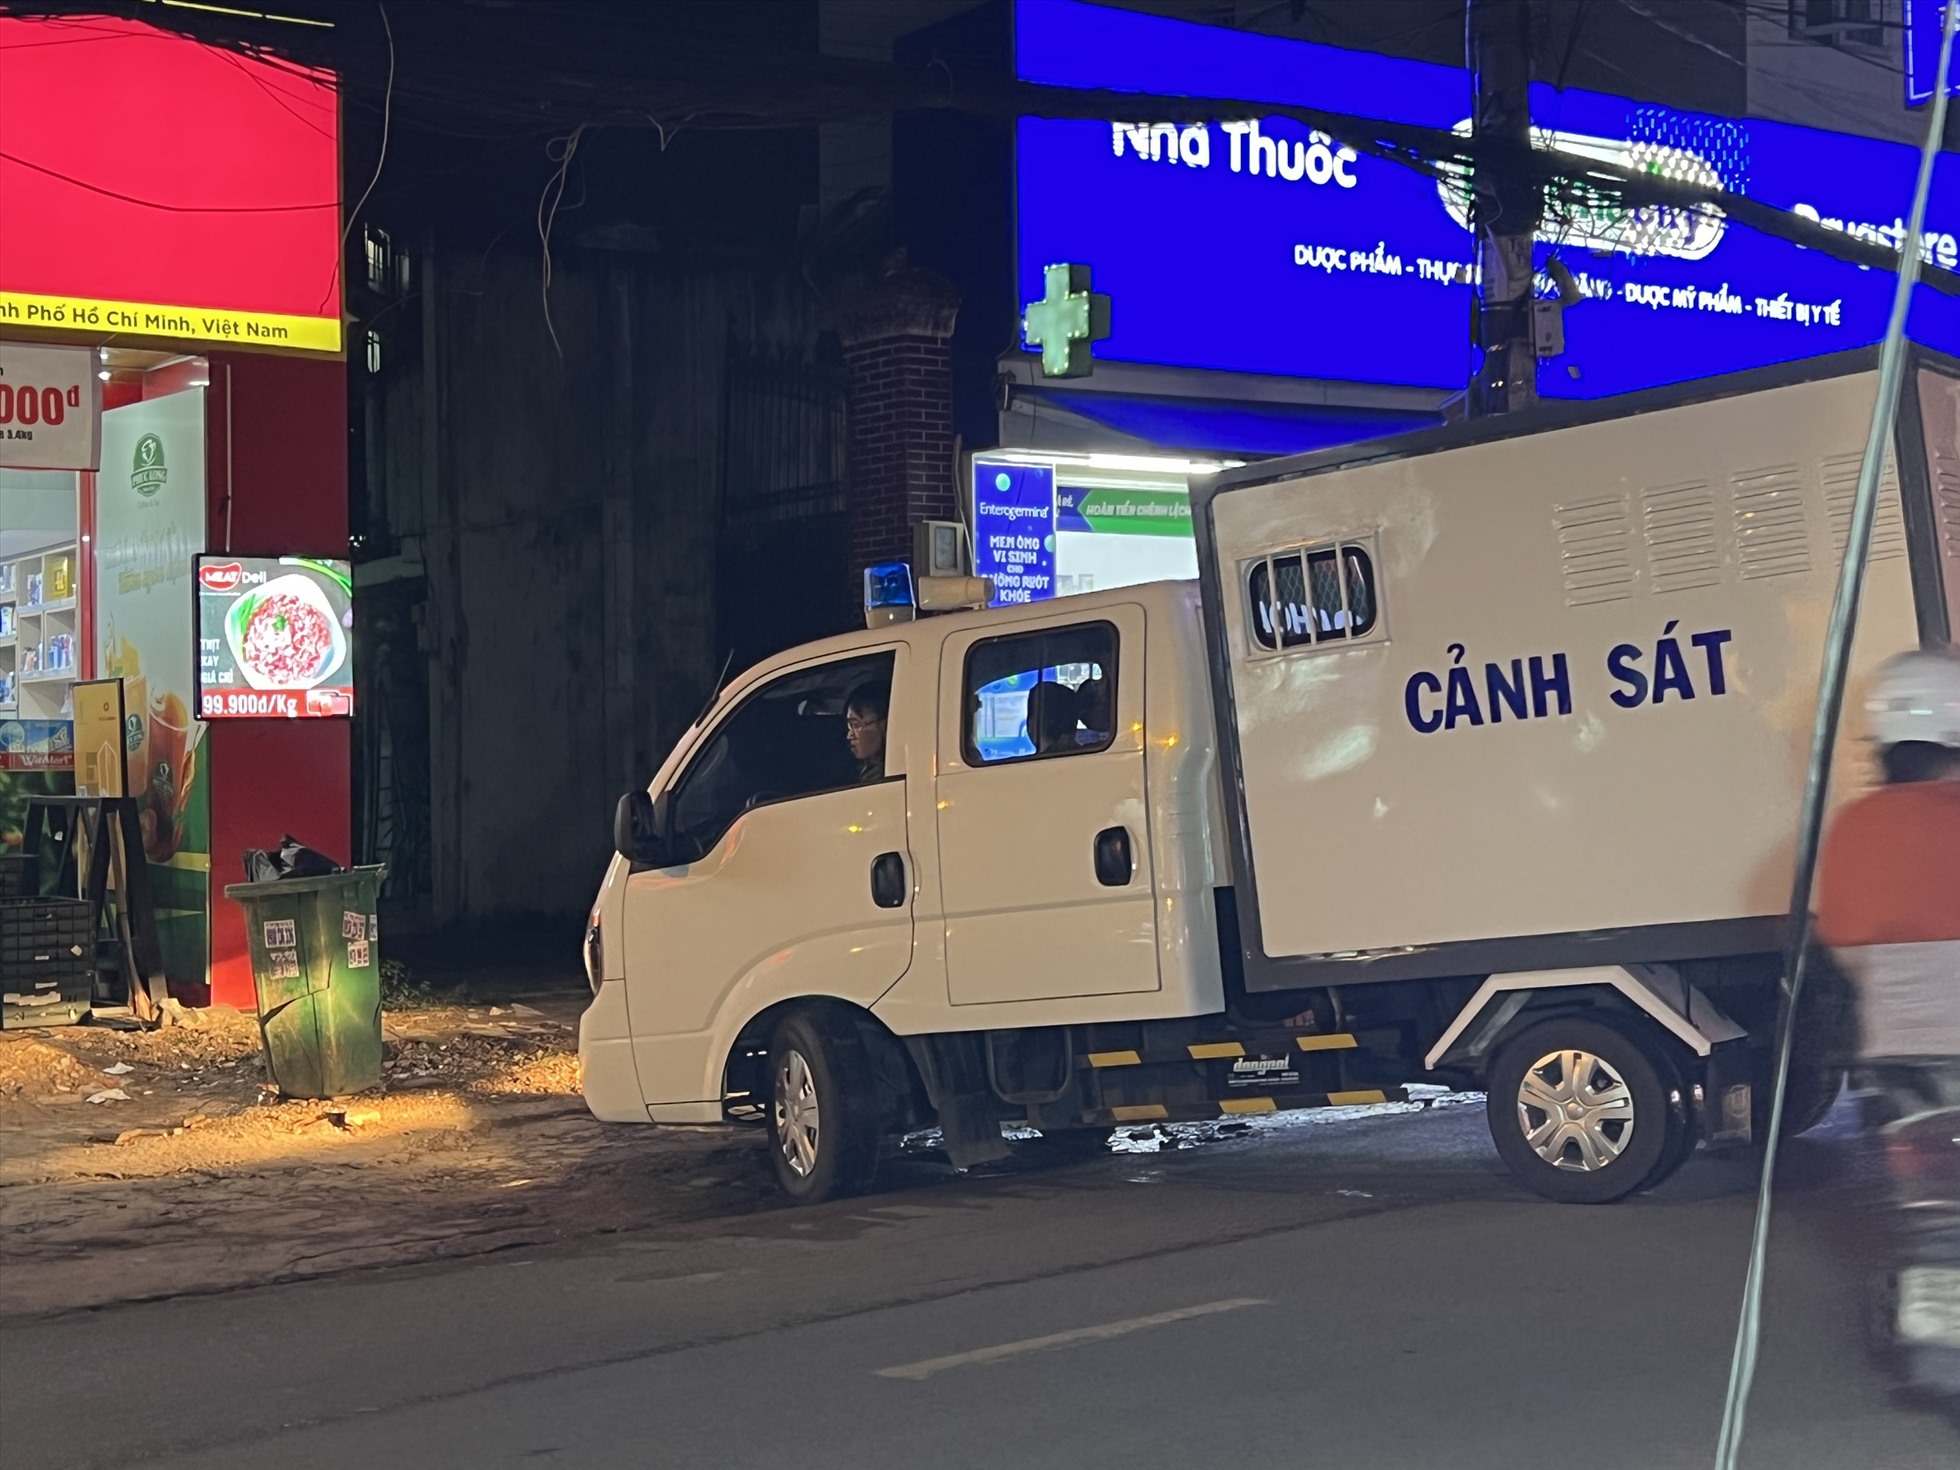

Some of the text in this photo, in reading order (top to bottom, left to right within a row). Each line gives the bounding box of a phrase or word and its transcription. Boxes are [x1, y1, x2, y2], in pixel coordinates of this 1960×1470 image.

[1350, 241, 1402, 275] PHẨM
[1416, 258, 1467, 286] THỰ
[27, 303, 66, 321] Phố
[73, 306, 99, 324] Hồ
[107, 311, 138, 327] Chí
[145, 314, 195, 335] Minh,
[202, 318, 239, 338] Việt
[247, 322, 288, 338] Nam
[1699, 282, 1743, 314] PHẨM
[1755, 292, 1795, 321] THIẾT
[1796, 303, 1810, 327] BỊ
[1811, 306, 1823, 323] Y
[1823, 299, 1842, 326] TẾ
[990, 535, 1014, 548] MEN
[993, 549, 1037, 564] VI SINH
[205, 571, 267, 584] MEAT Deli
[1405, 620, 1732, 734] CẢNH SÁT
